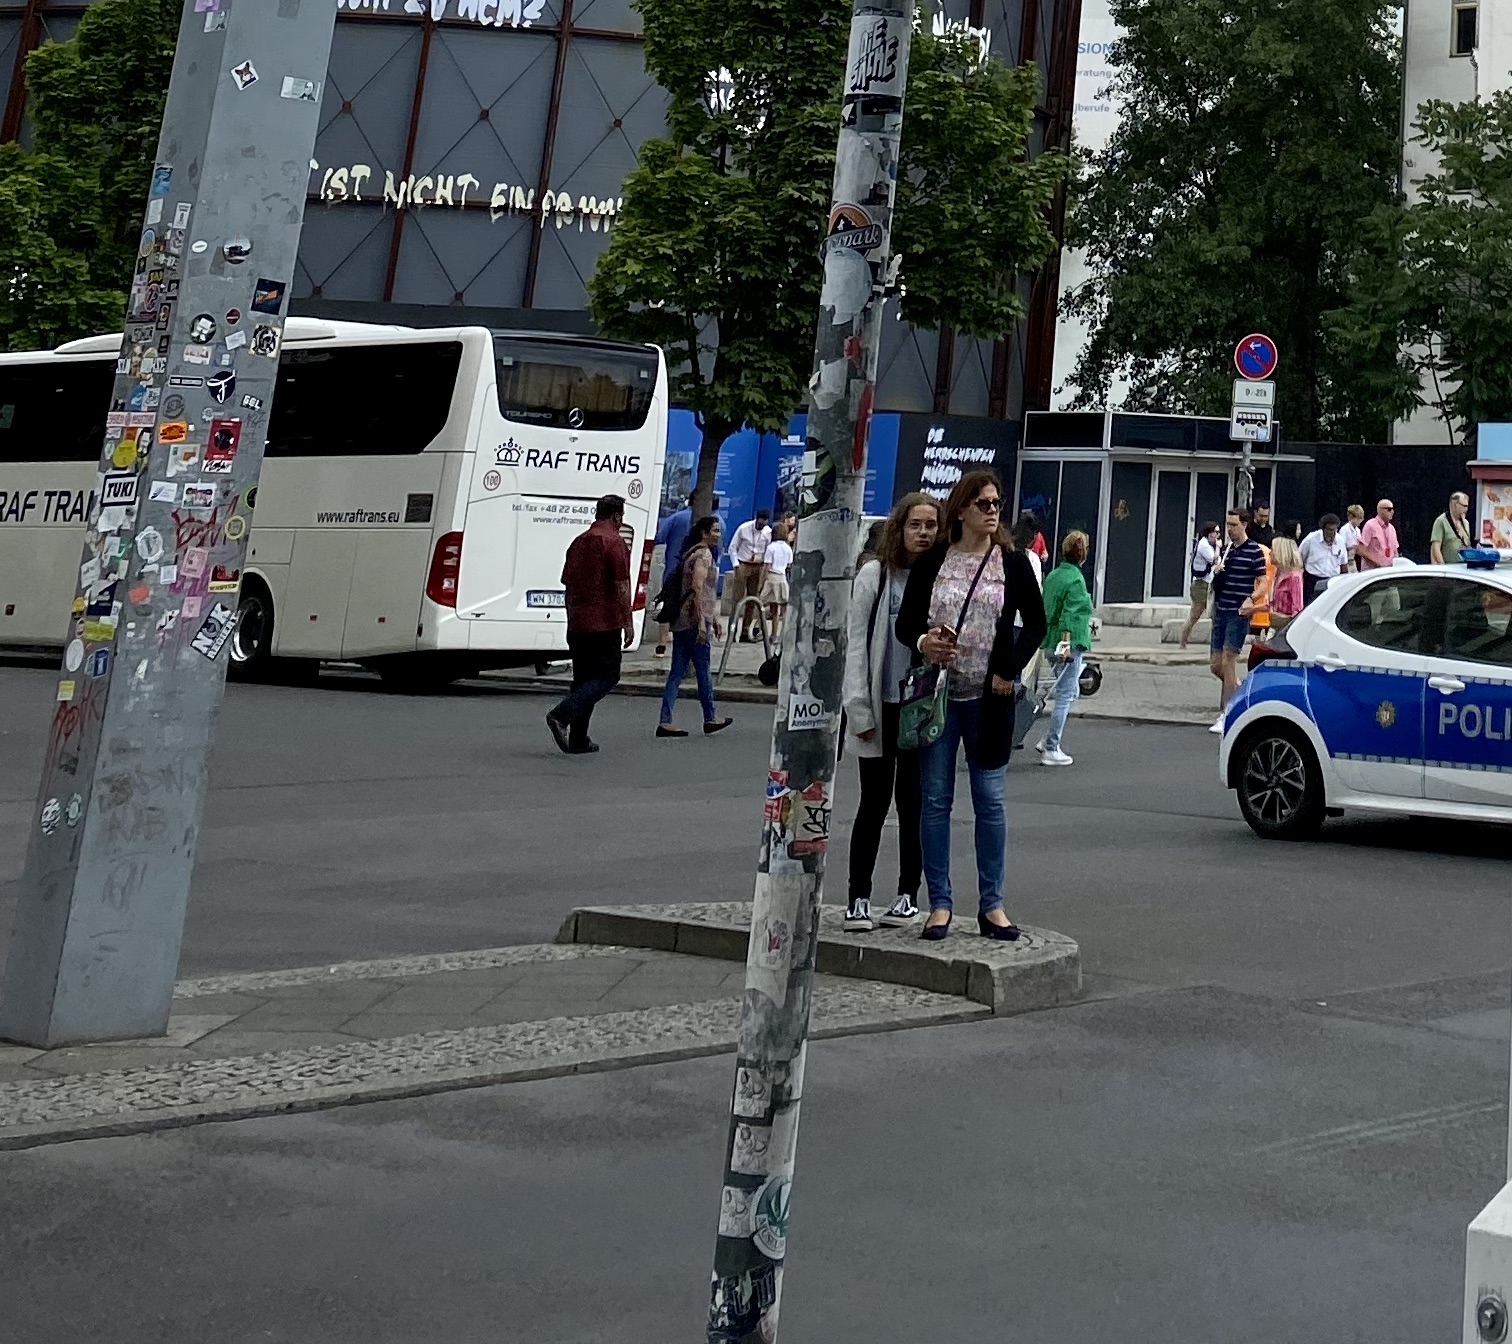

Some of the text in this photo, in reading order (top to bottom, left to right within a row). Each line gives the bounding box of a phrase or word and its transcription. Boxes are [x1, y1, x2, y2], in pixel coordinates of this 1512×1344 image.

[320, 164, 371, 201] IST
[384, 170, 479, 209] NICHT
[525, 448, 641, 474] RAF TRANS
[107, 481, 135, 498] TUKI
[317, 508, 400, 523] www.raftrans.eu
